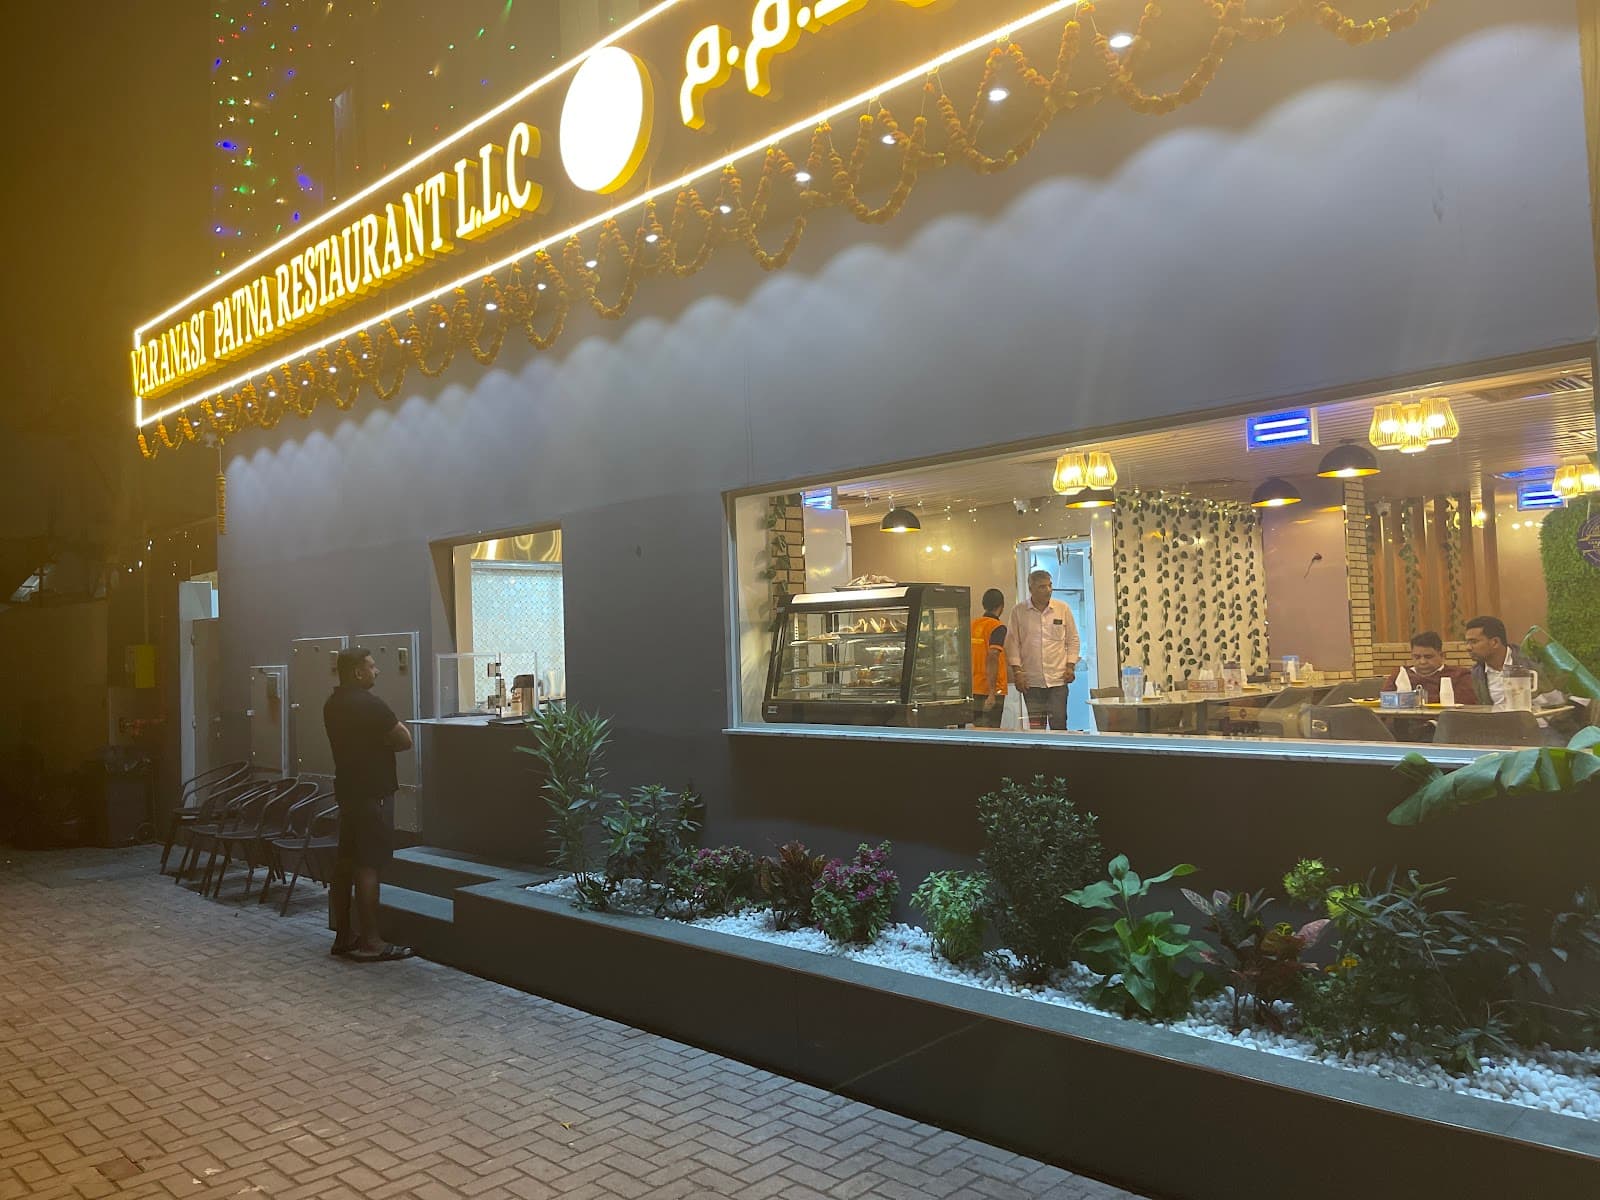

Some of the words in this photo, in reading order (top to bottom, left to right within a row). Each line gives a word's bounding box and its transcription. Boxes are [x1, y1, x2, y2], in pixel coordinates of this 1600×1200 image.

[131, 310, 208, 397] VARANASI
[213, 276, 275, 359] PATNA
[276, 172, 448, 328] RESTAURANT
[454, 122, 536, 239] L.L.C
